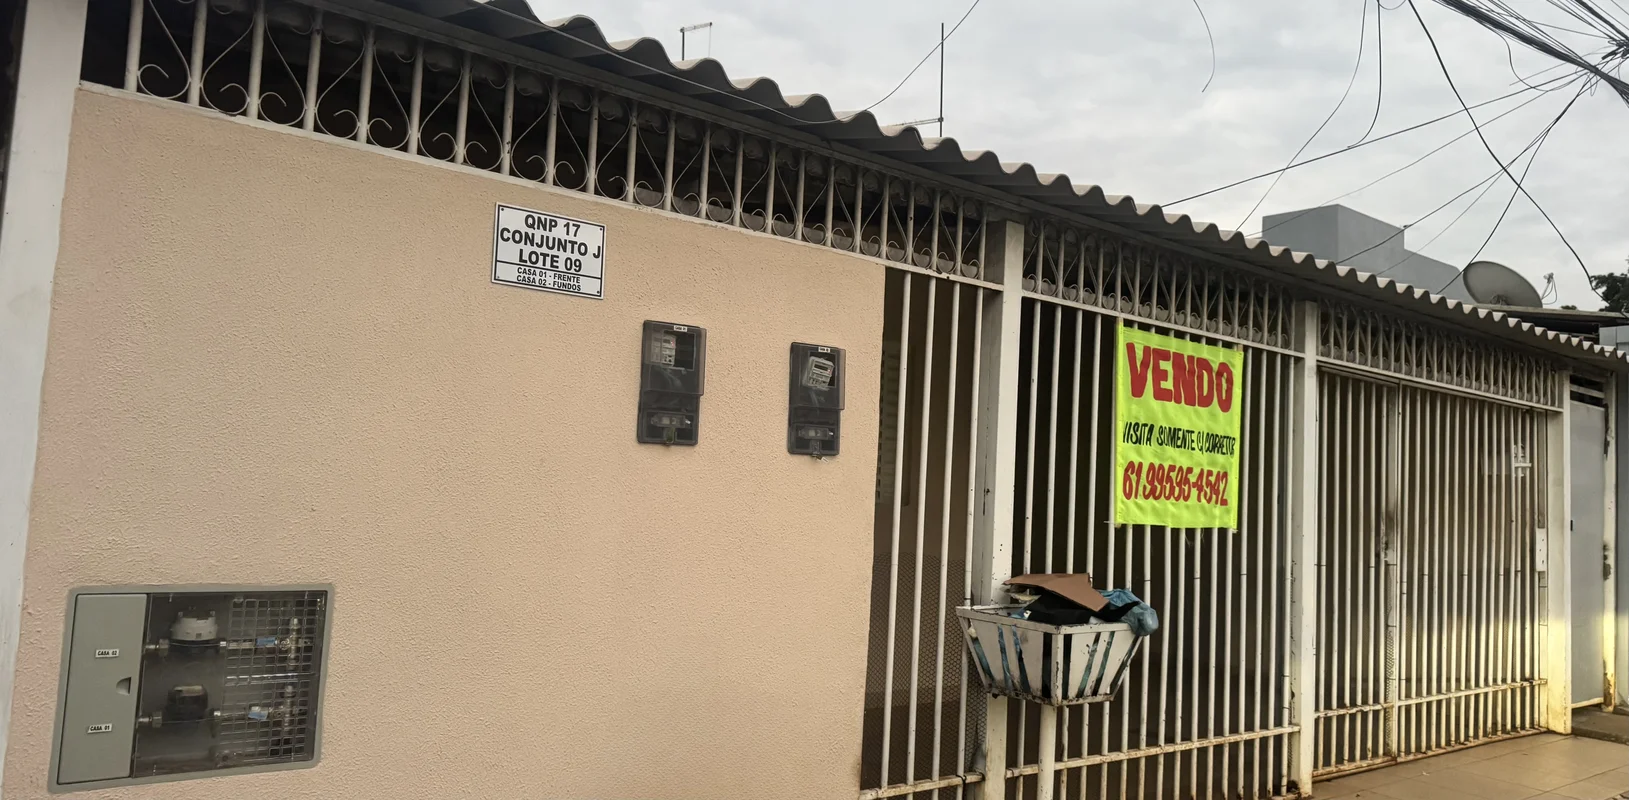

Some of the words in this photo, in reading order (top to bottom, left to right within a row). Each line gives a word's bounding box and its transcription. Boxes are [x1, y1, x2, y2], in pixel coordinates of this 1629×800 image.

[525, 214, 558, 233] QNP
[564, 222, 581, 237] 17
[500, 227, 588, 257] CONJUNTO
[593, 246, 601, 259] J
[519, 249, 560, 269] LOTE
[564, 257, 582, 273] 09
[517, 267, 537, 277] CASA
[554, 273, 581, 284] FRENTE
[517, 275, 536, 285] CASA
[538, 279, 547, 287] 02
[553, 281, 582, 292] FUNDOS
[1126, 342, 1234, 413] VENDO
[1157, 425, 1196, 451] SOMENTE
[1205, 432, 1236, 456] CORRETOR
[1123, 460, 1143, 501] 61
[1143, 462, 1229, 506] 99595-4542
